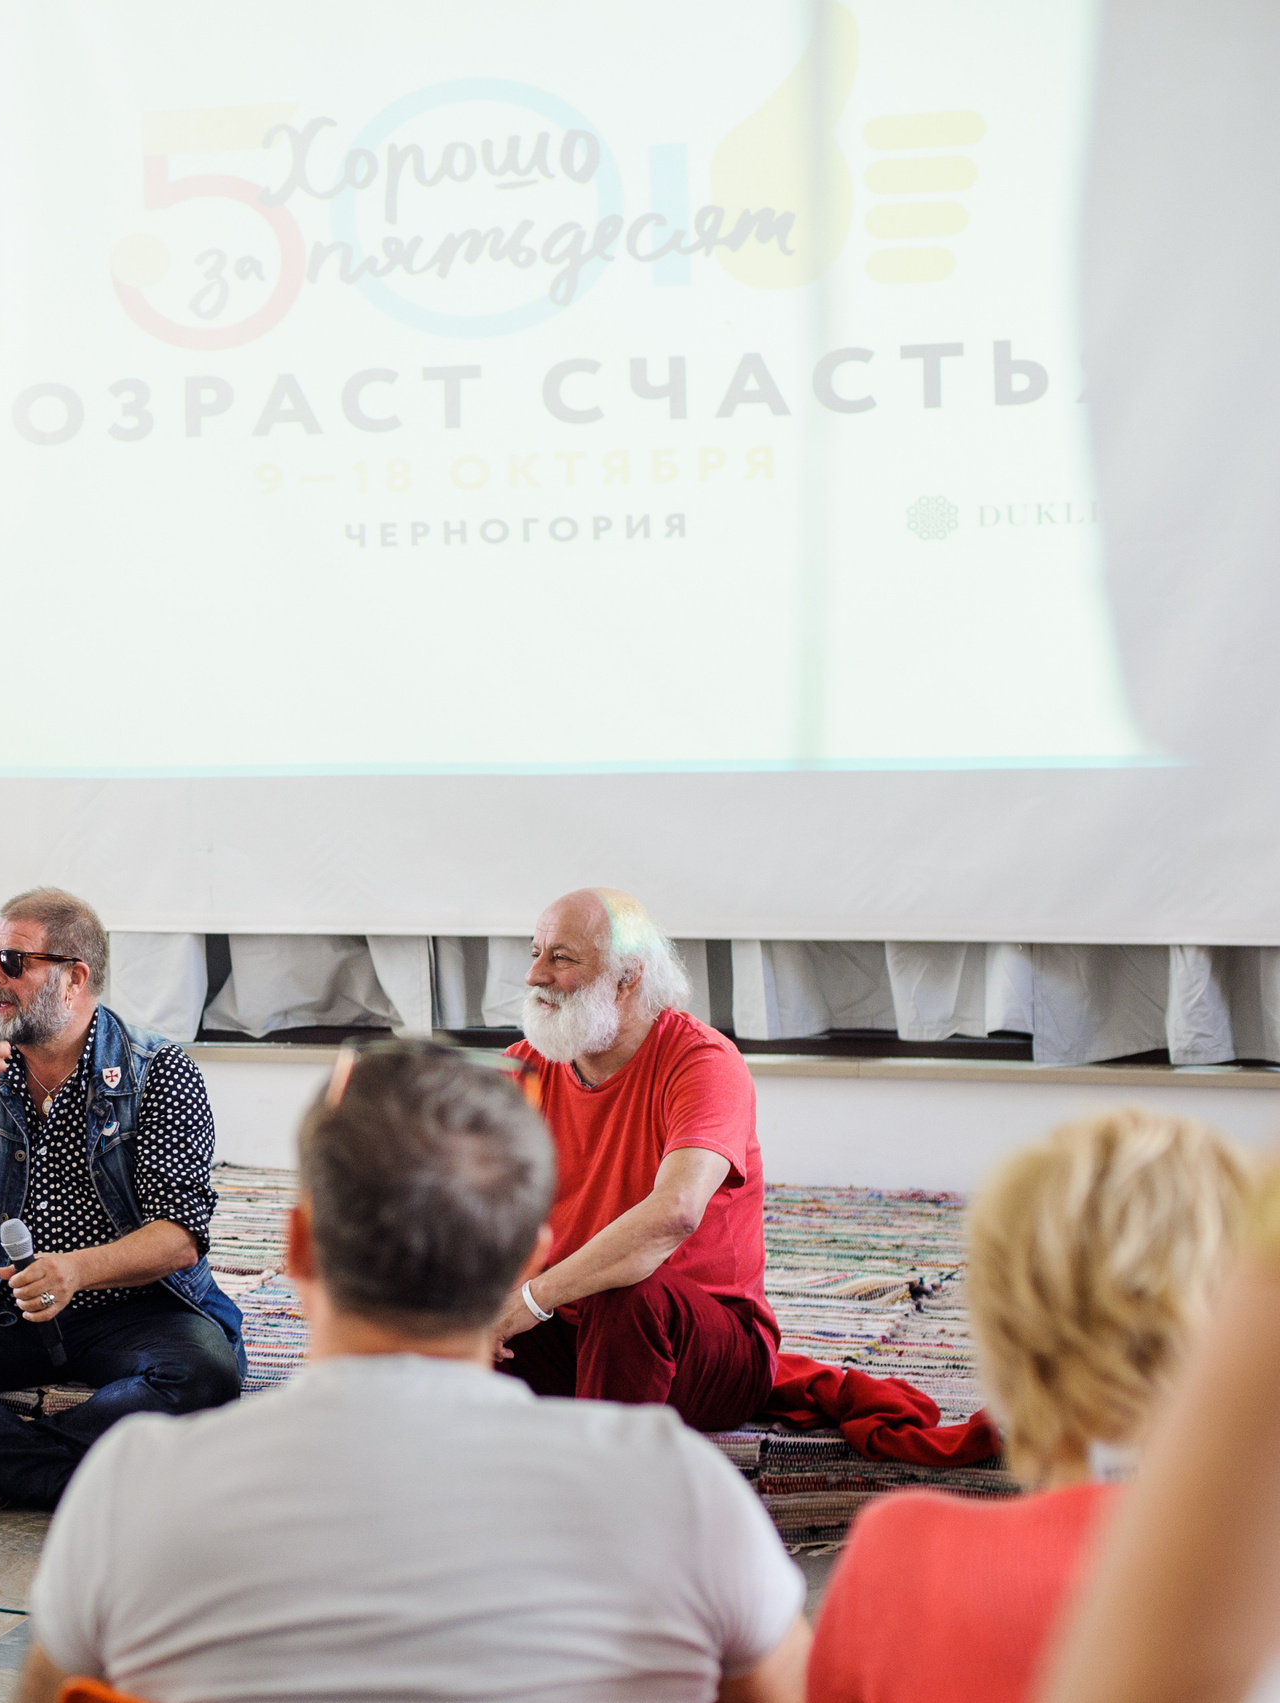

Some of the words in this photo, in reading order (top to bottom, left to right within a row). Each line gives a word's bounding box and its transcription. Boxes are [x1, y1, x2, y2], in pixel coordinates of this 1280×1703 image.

[256, 115, 601, 225] Хорошо
[187, 247, 267, 320] за
[305, 203, 796, 307] пятьдесят
[541, 339, 1088, 425] СЧАСТЬ
[449, 444, 776, 491] ОКТЯБРЯ
[344, 512, 688, 549] ЧЕРНОГОРИЯ
